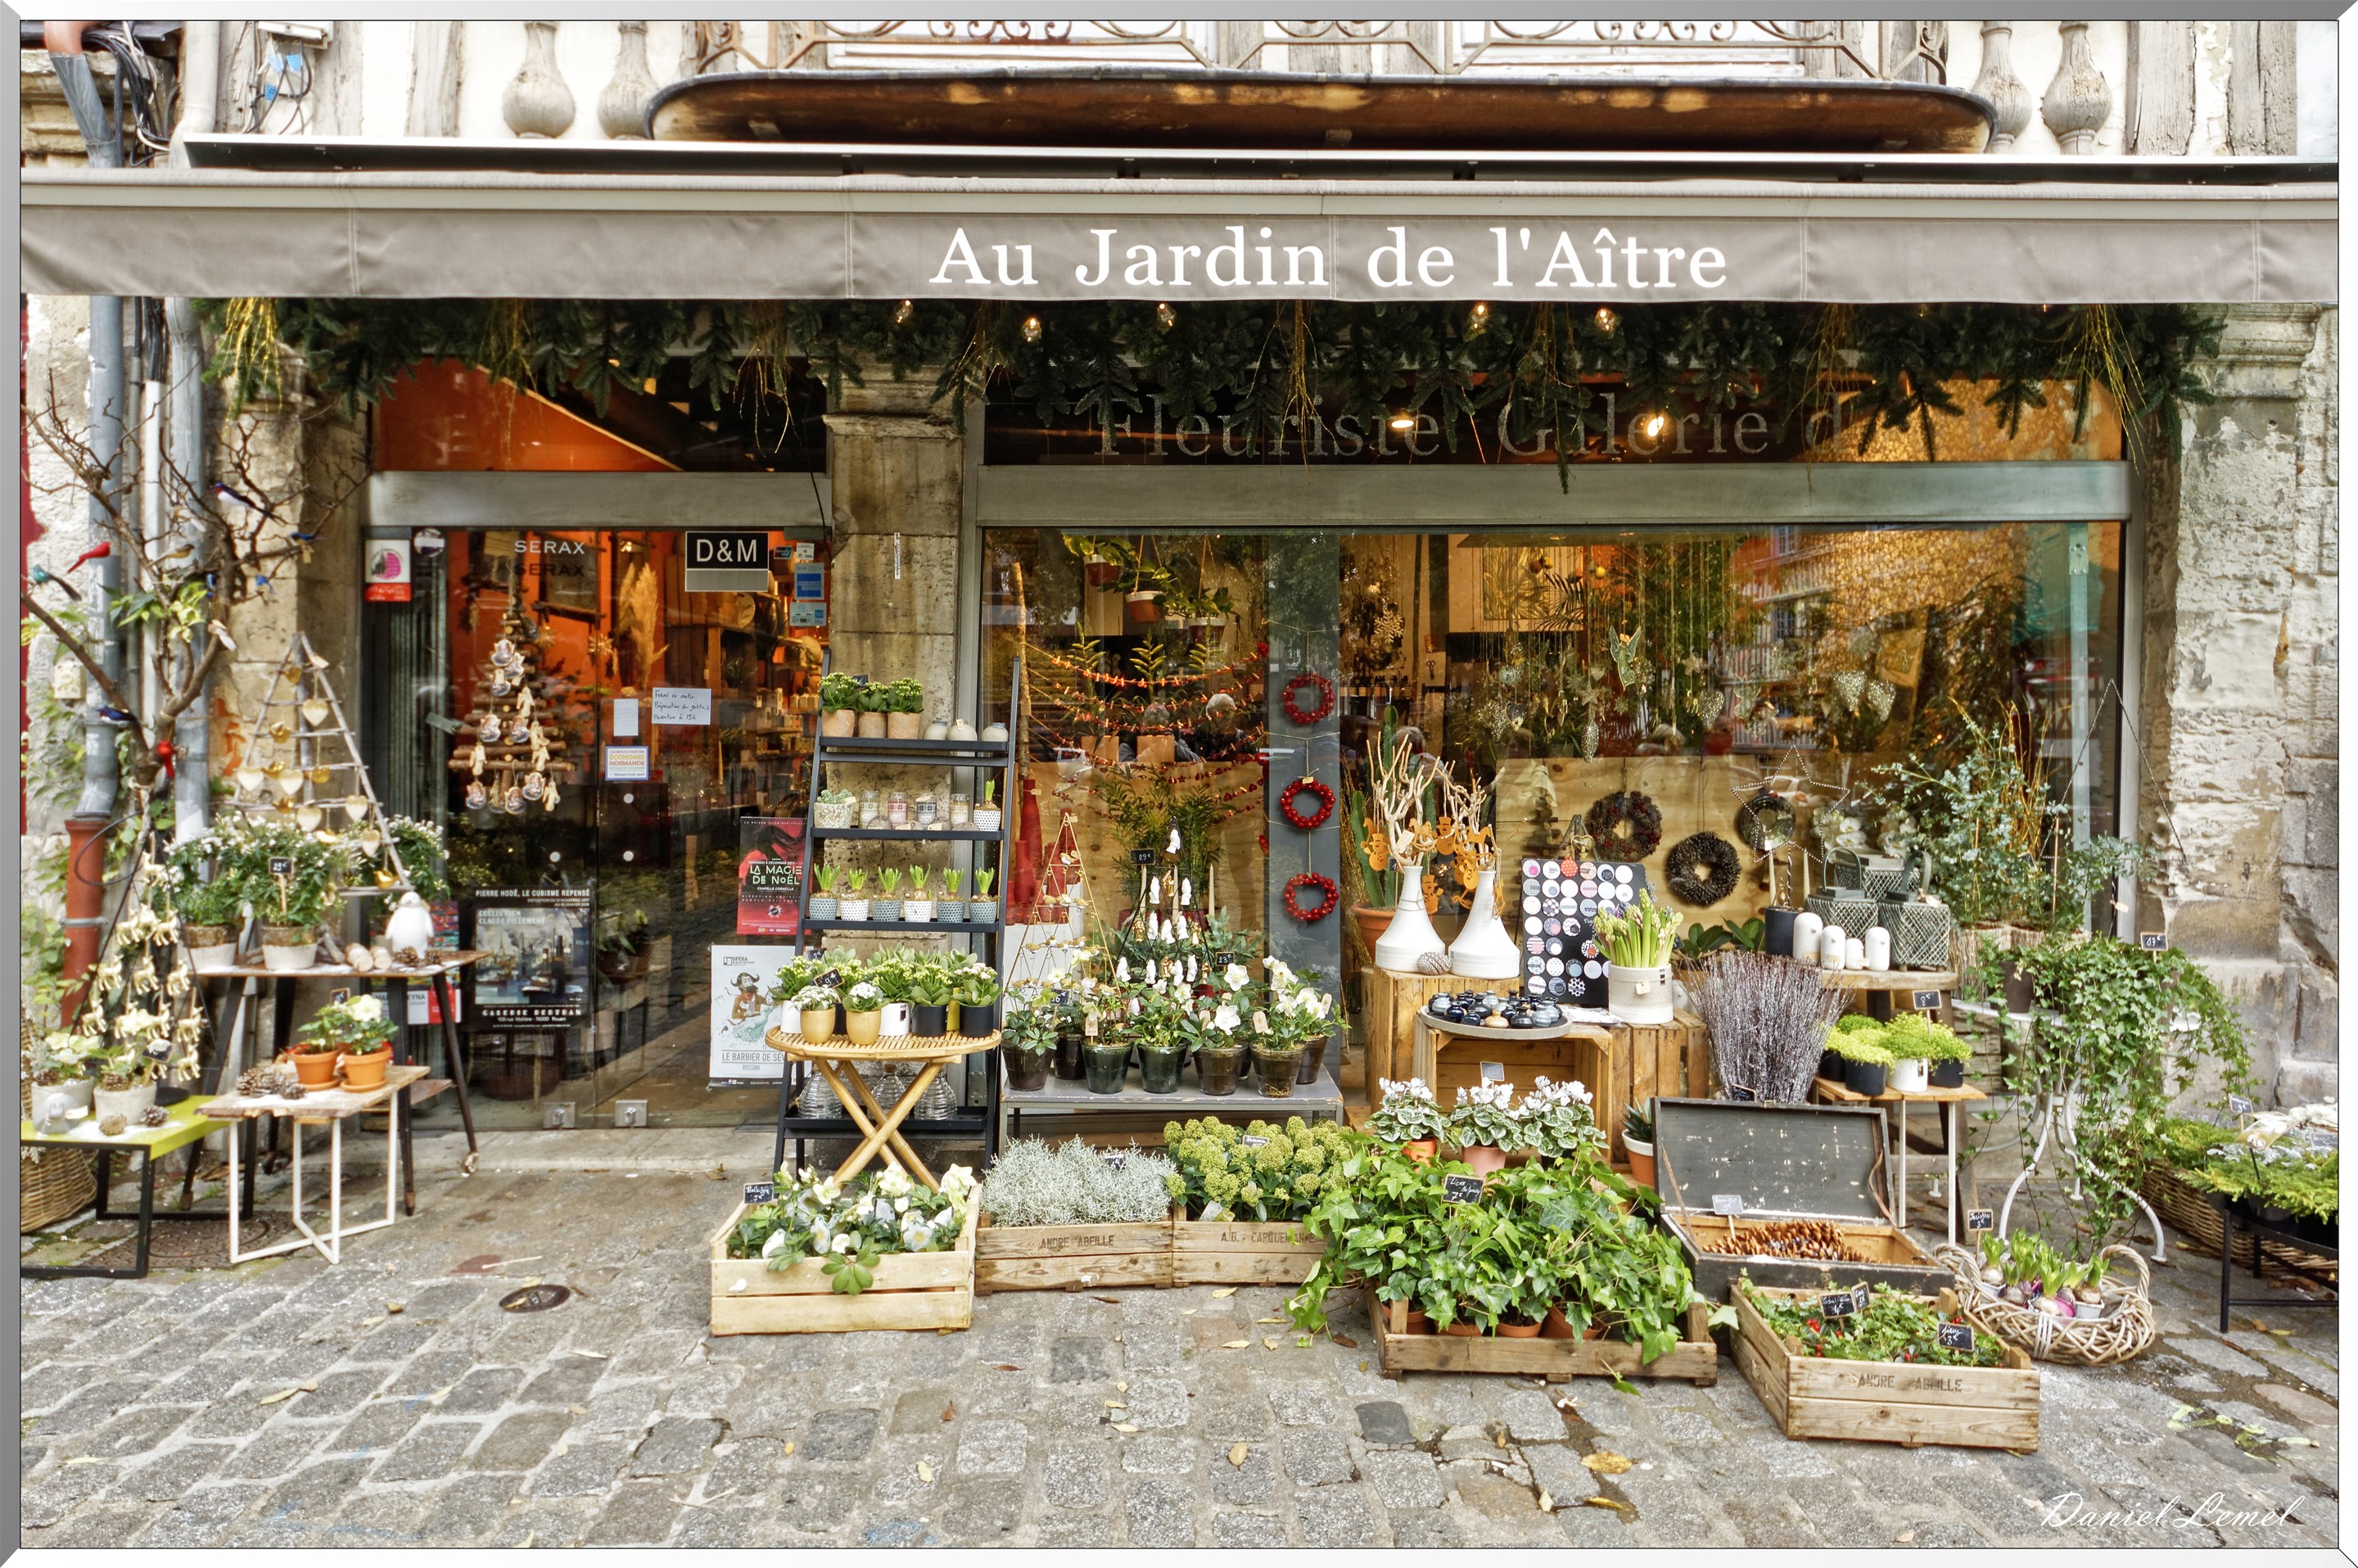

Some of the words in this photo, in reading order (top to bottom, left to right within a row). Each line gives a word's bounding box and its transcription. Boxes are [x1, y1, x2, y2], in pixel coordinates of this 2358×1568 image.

[928, 227, 1039, 286] Au
[1074, 225, 1330, 287] Jardin
[1366, 226, 1457, 288] de
[1488, 227, 1728, 288] l'Aître
[514, 540, 585, 554] SERAX
[696, 539, 757, 563] D&M
[749, 865, 761, 875] LA
[766, 865, 802, 874] MAGIE
[752, 875, 766, 884] DE
[476, 889, 499, 897] PIERRE
[561, 888, 590, 897] REPENSÉ
[722, 1052, 730, 1061] LE
[732, 1052, 761, 1061] BARBIER
[762, 1053, 771, 1062] DE
[1077, 1234, 1114, 1248] ABEILLE
[1858, 1373, 1895, 1389] ANDRE
